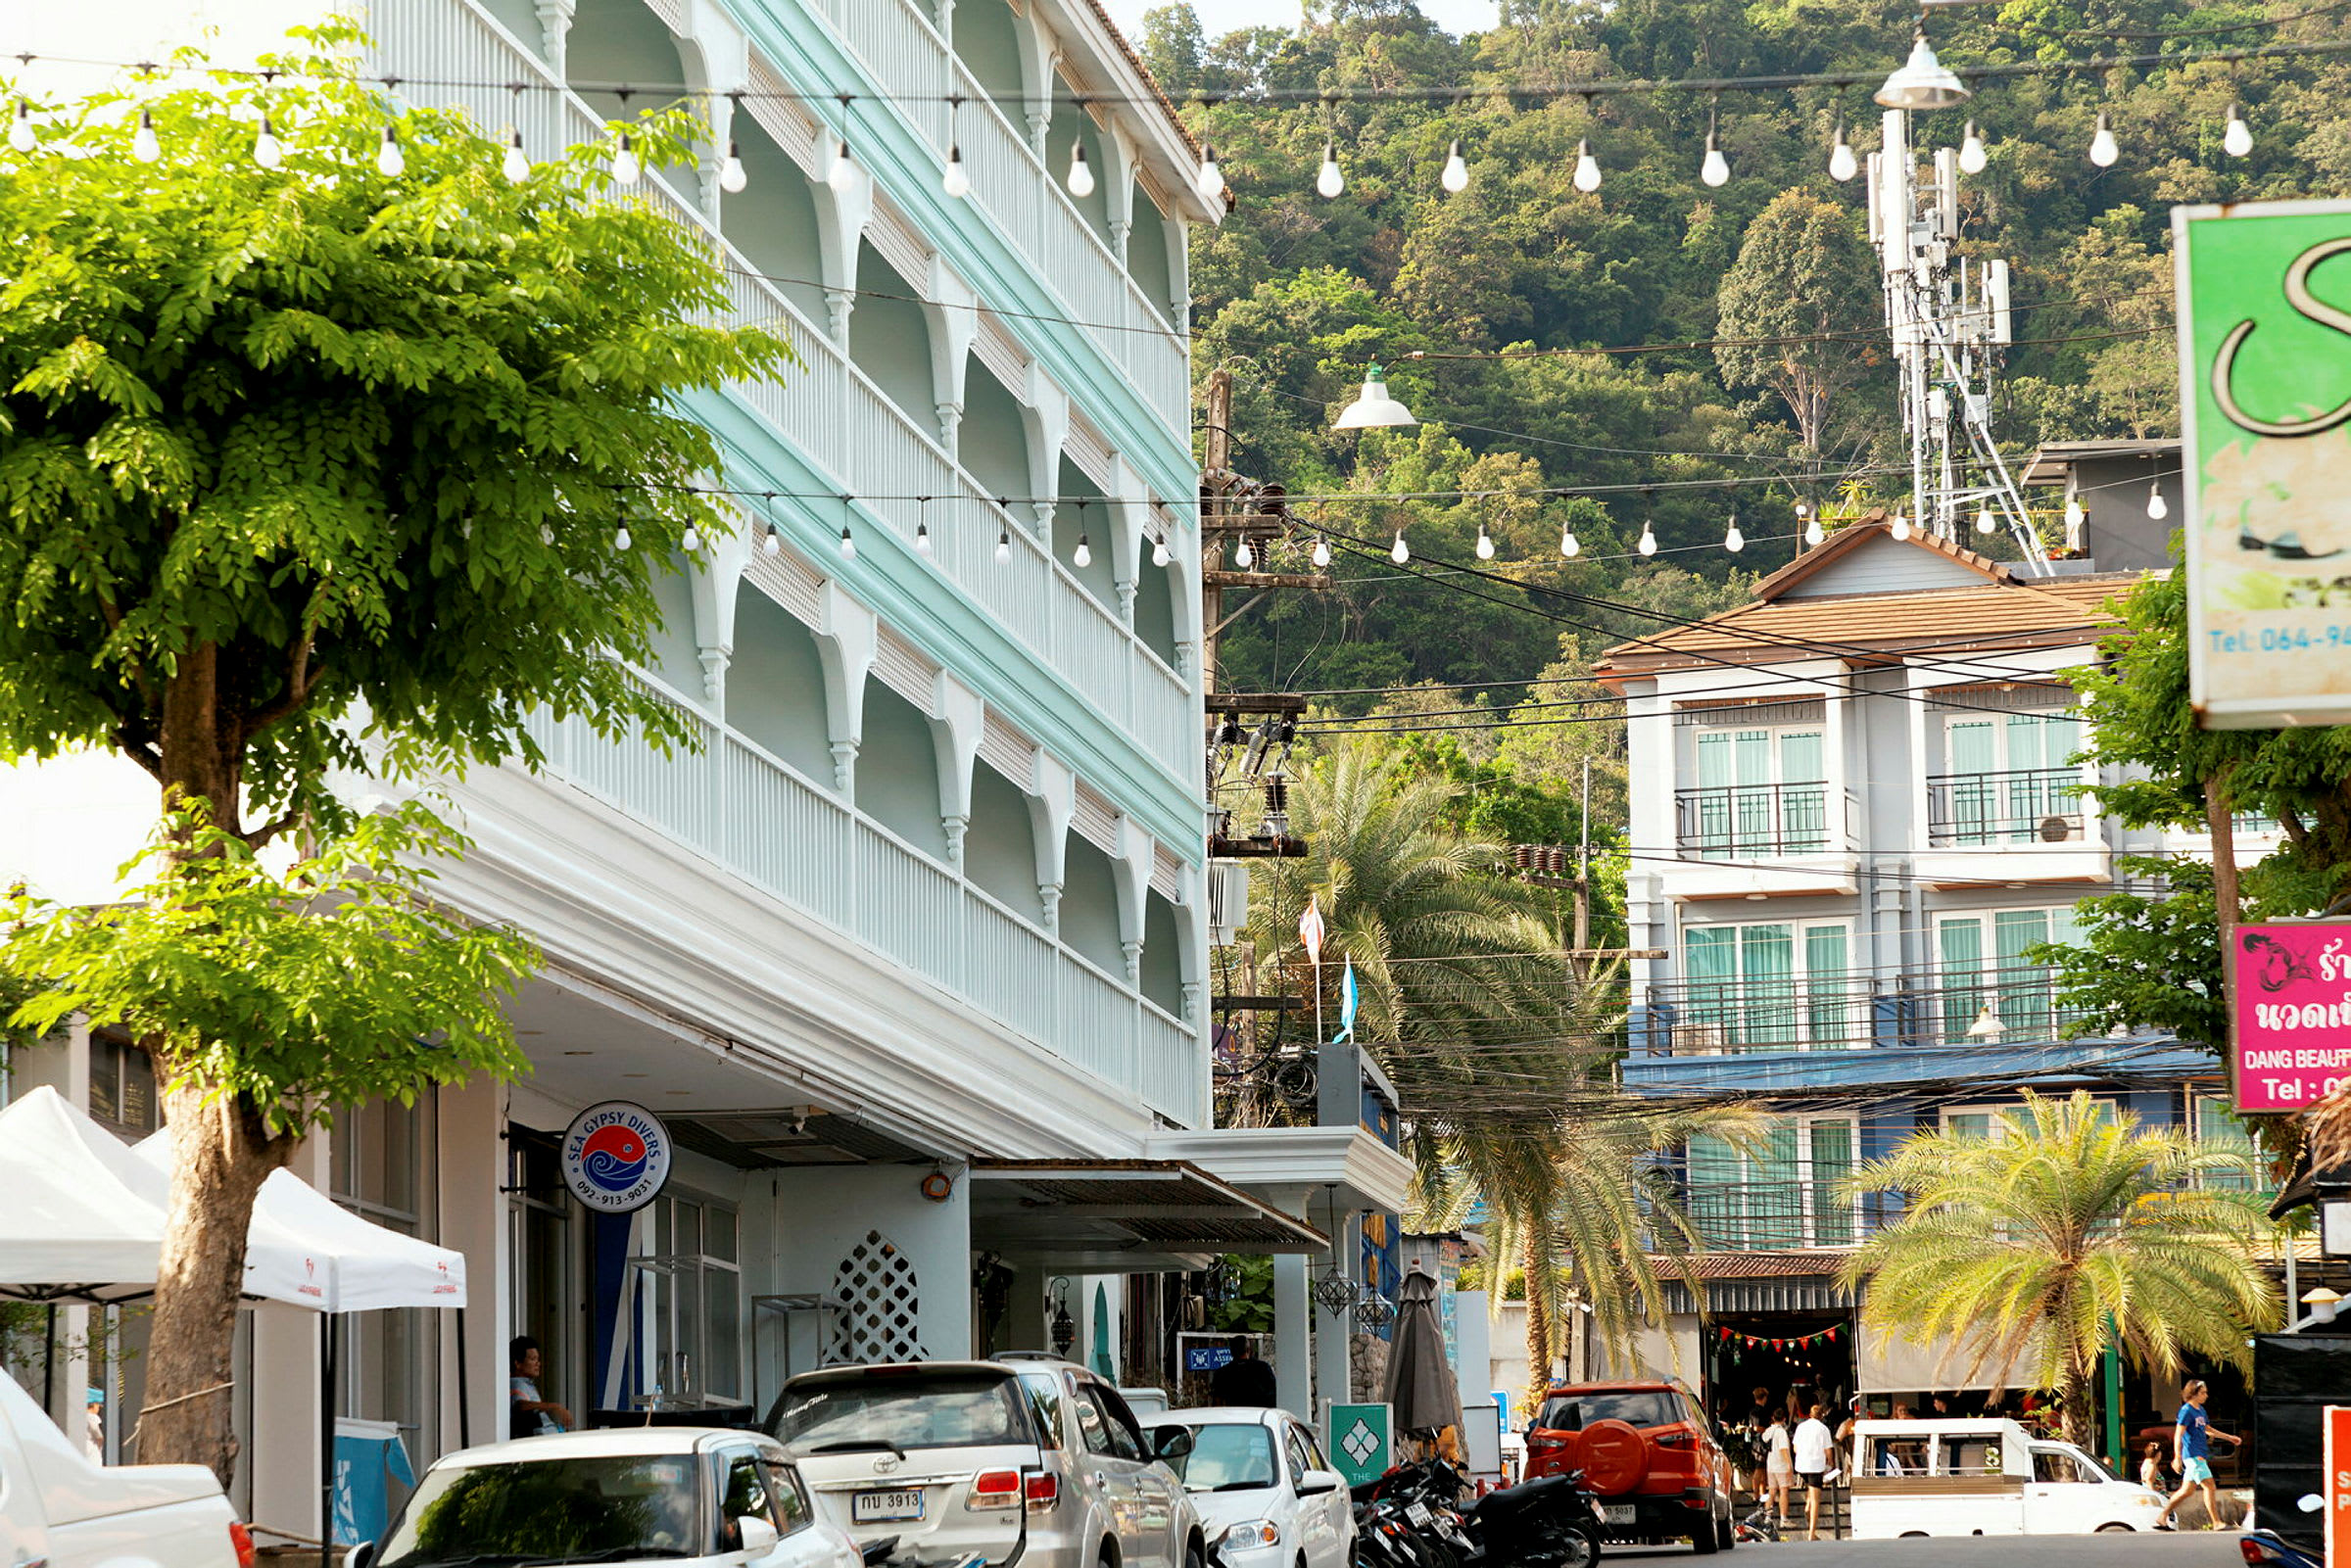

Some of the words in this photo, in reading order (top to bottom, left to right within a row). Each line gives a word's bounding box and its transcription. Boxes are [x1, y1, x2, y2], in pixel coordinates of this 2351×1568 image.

[2244, 1049, 2293, 1069] DANG
[568, 1135, 587, 1162] SEA
[584, 1112, 626, 1134] GYPSY
[627, 1115, 661, 1159] DIVERS
[577, 1178, 652, 1206] 092-913-9031
[1353, 1472, 1371, 1482] THE
[888, 1493, 919, 1508] 3913
